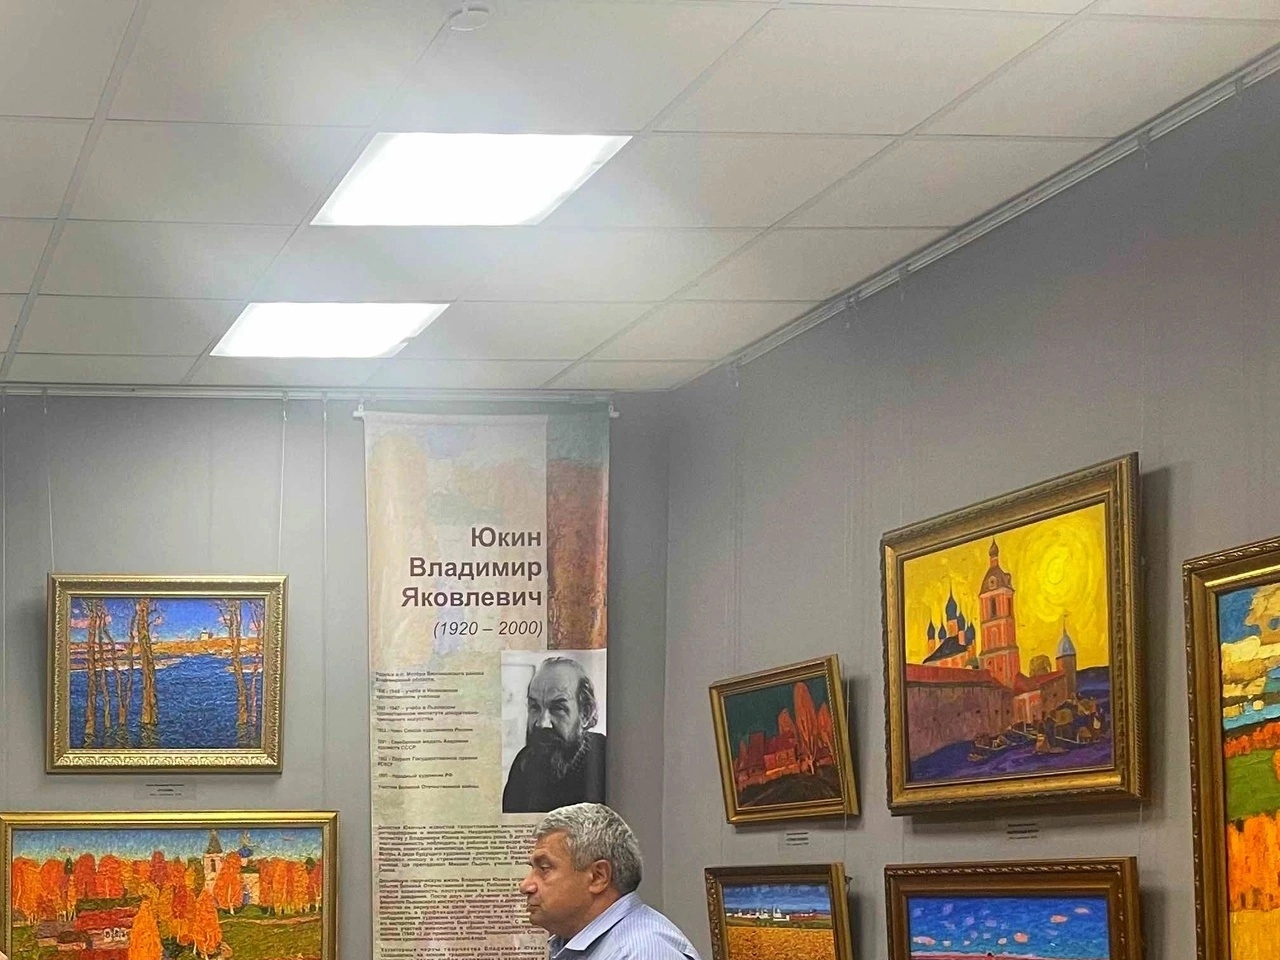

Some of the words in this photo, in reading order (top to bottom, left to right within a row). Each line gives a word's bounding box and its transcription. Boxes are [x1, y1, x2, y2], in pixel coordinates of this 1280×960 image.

[471, 527, 542, 547] Юкин
[409, 557, 543, 581] Владимир
[401, 586, 543, 607] Яковлевич
[433, 620, 478, 638] (1920
[498, 620, 543, 638] 2000)
